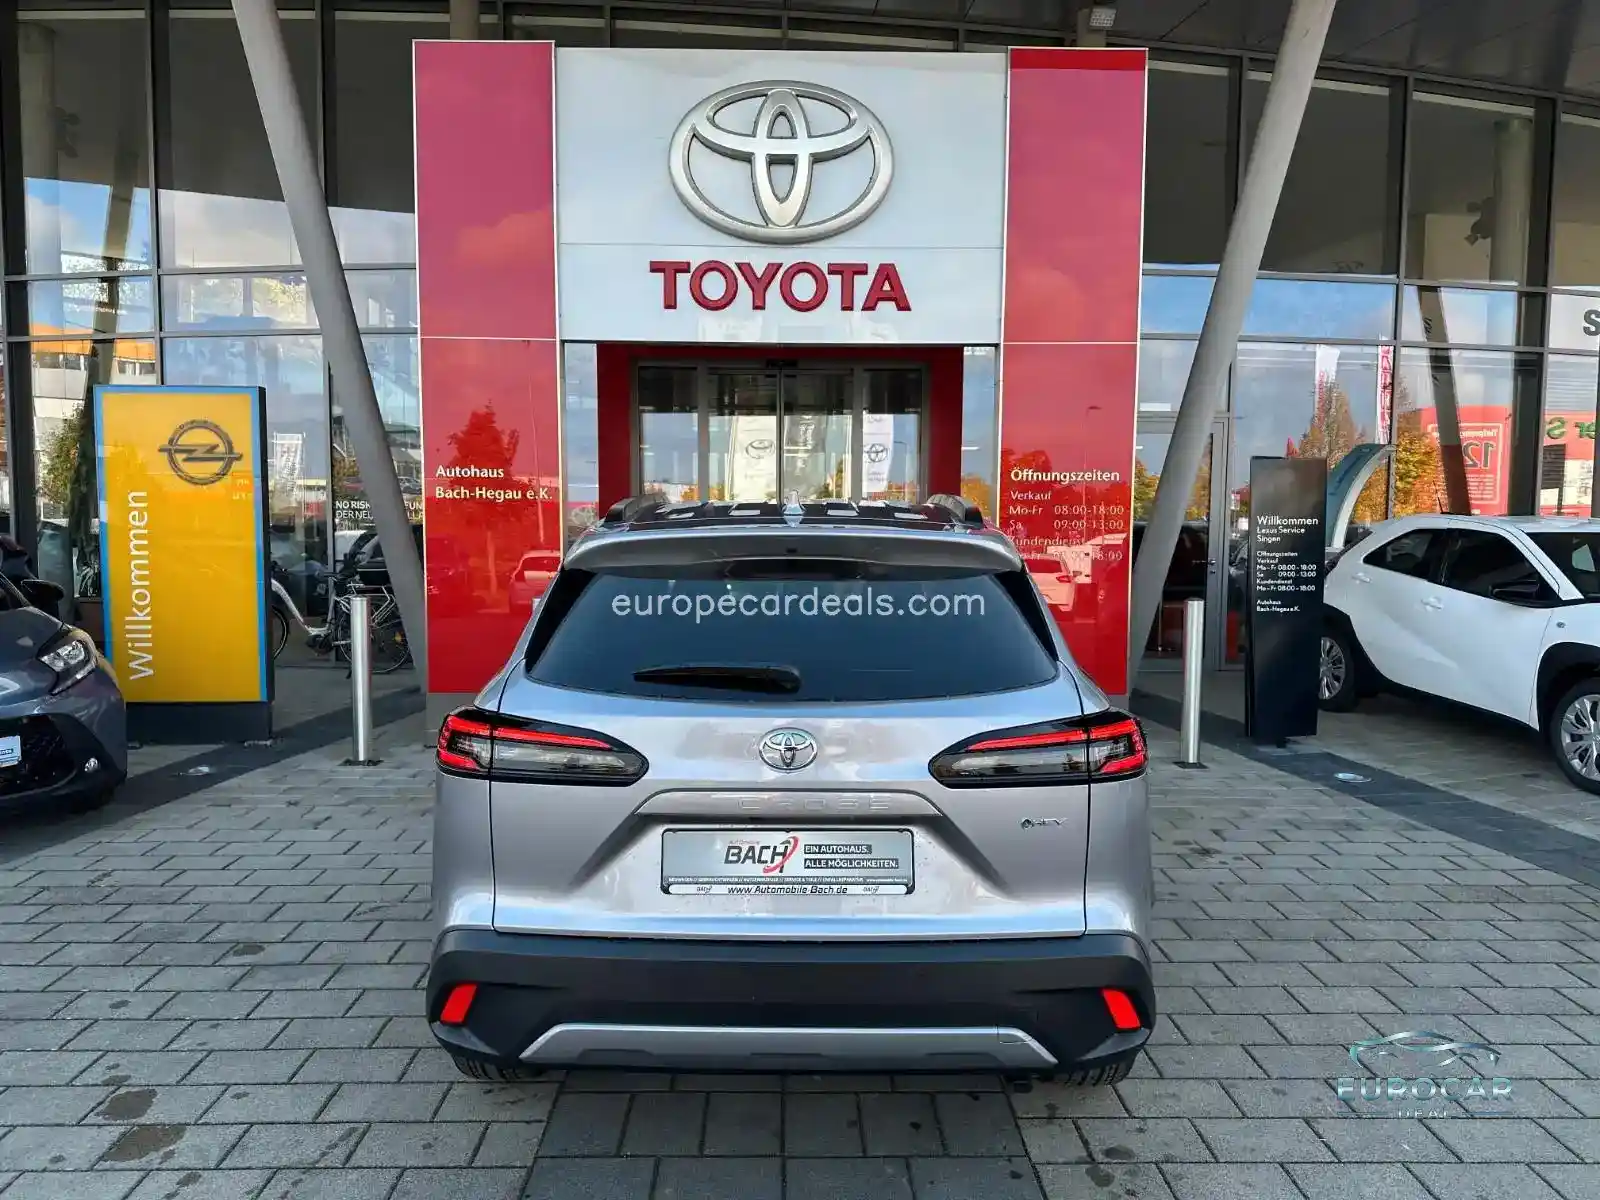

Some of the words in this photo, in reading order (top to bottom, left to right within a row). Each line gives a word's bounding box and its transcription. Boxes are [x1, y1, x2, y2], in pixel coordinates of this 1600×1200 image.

[649, 260, 912, 312] TOYOTA
[435, 465, 505, 478] Autohaus
[1010, 466, 1120, 484] Öffnungszeiten
[435, 486, 522, 502] Bach-Hegau
[526, 488, 553, 500] e.K.
[1010, 490, 1052, 501] Verkauf
[335, 500, 350, 509] NO
[336, 510, 355, 519] DER
[1009, 505, 1044, 515] Mo-Fr
[1053, 505, 1125, 516] 08:00-18:00
[1053, 519, 1124, 530] 09:00-13:00
[1256, 515, 1319, 525] Willkommen
[1256, 526, 1278, 534] Lexus
[1278, 526, 1305, 534] Service
[1256, 535, 1281, 544] Singen
[124, 489, 155, 681] Willkommen
[805, 844, 819, 855] EIN
[820, 844, 870, 855] AUTOHAUS.
[724, 843, 792, 873] BACH
[804, 857, 827, 869] ALLE
[828, 856, 899, 869] MÖGLICHKEITEN.
